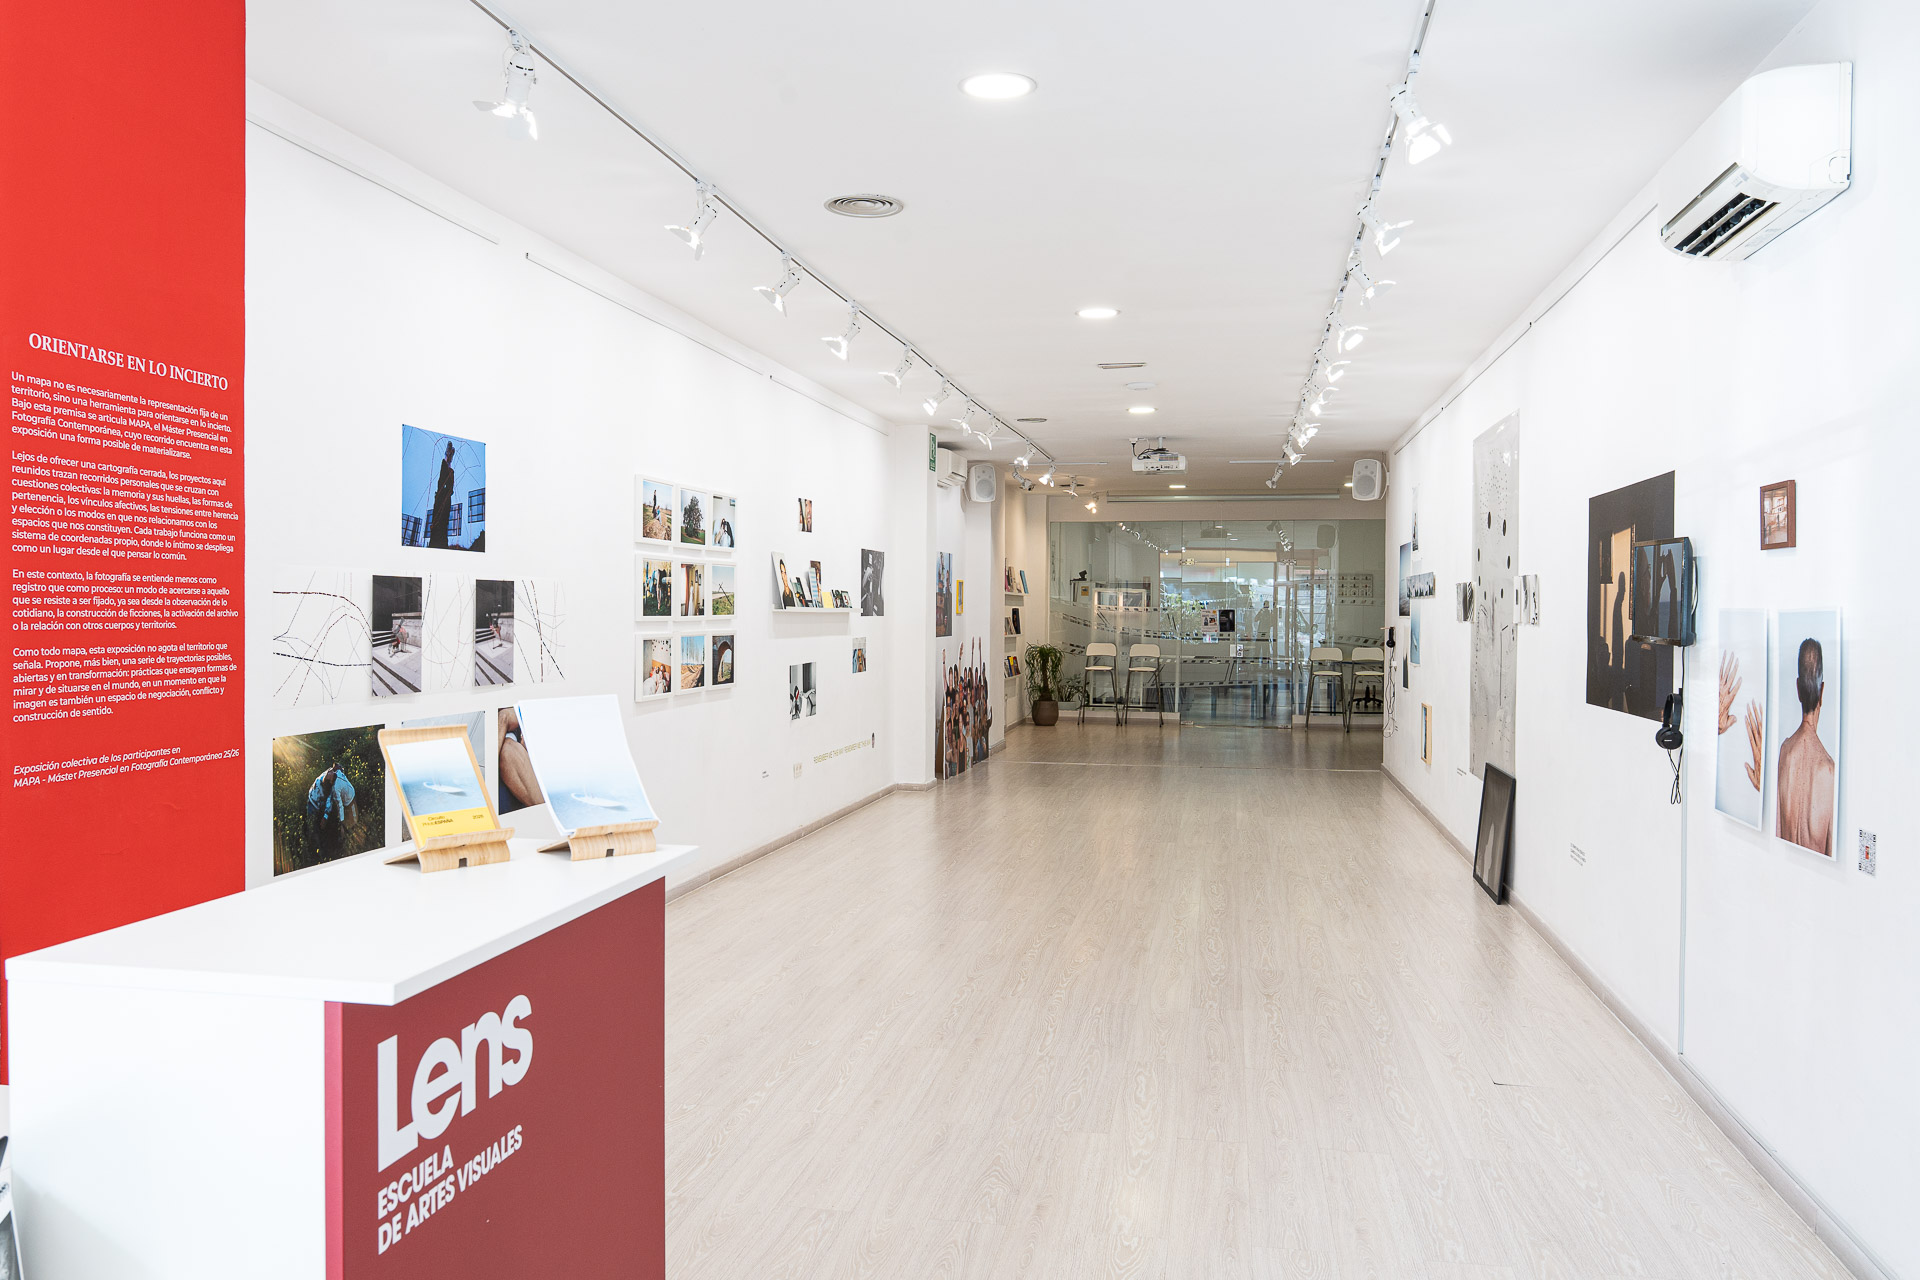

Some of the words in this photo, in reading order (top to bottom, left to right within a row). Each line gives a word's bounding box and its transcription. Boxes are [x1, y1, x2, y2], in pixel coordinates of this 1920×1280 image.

[28, 332, 124, 368] ORIENTARSE
[126, 354, 146, 373] EN
[148, 359, 167, 377] LO
[169, 364, 228, 391] INCIERTO
[11, 370, 25, 382] Un
[26, 375, 52, 388] mapa
[53, 380, 65, 390] no
[65, 383, 76, 392] es
[76, 385, 139, 404] necesariamente
[139, 395, 147, 405] la
[147, 399, 199, 415] representación
[199, 407, 210, 419] fija
[210, 410, 219, 420] de
[219, 413, 229, 421] un
[11, 397, 32, 411] Bajo
[33, 402, 52, 413] esta
[53, 406, 87, 419] premisa
[87, 412, 97, 421] se
[97, 413, 128, 426] articula
[128, 417, 153, 431] MAPA,
[153, 422, 161, 431] el
[161, 423, 185, 435] Máster
[186, 427, 219, 441] Presencial
[219, 435, 228, 443] en
[11, 410, 56, 426] Fotografía
[57, 418, 123, 438] Contemporánea,
[123, 430, 143, 441] cuyo
[143, 433, 175, 445] recorrido
[175, 439, 210, 451] encuentra
[210, 444, 219, 453] en
[219, 446, 233, 455] esta
[11, 425, 58, 439] exposición
[59, 432, 76, 442] una
[76, 433, 101, 446] forma
[102, 439, 131, 450] posible
[130, 442, 141, 452] de
[142, 445, 192, 459] materializarse.
[11, 450, 36, 463] Lejos
[36, 453, 49, 464] de
[49, 455, 79, 467] ofrecer
[80, 460, 96, 470] una
[97, 463, 139, 475] cartografía
[139, 468, 168, 480] cerrada,
[168, 470, 179, 480] los
[179, 474, 212, 485] proyectos
[211, 478, 227, 487] aquí
[11, 465, 51, 477] reunidos
[51, 468, 78, 480] trazan
[79, 473, 119, 485] recorridos
[120, 478, 160, 490] personales
[160, 483, 174, 492] que
[174, 484, 183, 492] se
[183, 485, 207, 495] cruzan
[206, 488, 219, 496] con
[11, 491, 66, 505] pertenencia,
[67, 494, 80, 505] los
[80, 496, 114, 508] vínculos
[114, 499, 149, 513] afectivos,
[149, 503, 160, 513] las
[160, 505, 194, 516] tensiones
[194, 509, 212, 518] entre
[212, 509, 239, 521] herencia
[11, 517, 50, 528] espacios
[51, 520, 68, 531] que
[69, 522, 85, 531] nos
[85, 523, 133, 535] constituyen.
[133, 525, 153, 536] Cada
[153, 527, 179, 539] trabajo
[178, 528, 208, 540] funciona
[208, 533, 227, 541] como
[11, 544, 38, 553] como
[39, 545, 51, 554] un
[52, 544, 75, 557] lugar
[75, 545, 101, 556] desde
[101, 547, 110, 557] el
[110, 549, 126, 559] que
[126, 550, 152, 560] pensar
[153, 550, 160, 559] lo
[160, 551, 187, 561] común.
[12, 568, 25, 579] En
[26, 570, 45, 579] este
[46, 571, 85, 582] contexto,
[85, 571, 94, 581] la
[94, 571, 132, 583] fotografía
[132, 574, 141, 582] se
[141, 573, 174, 583] entiende
[174, 576, 198, 584] menos
[12, 607, 56, 619] cotidiano,
[56, 608, 65, 618] la
[65, 608, 117, 618] construcción
[117, 608, 129, 618] de
[129, 608, 163, 619] ficciones,
[163, 608, 170, 618] la
[171, 608, 205, 618] activación
[205, 608, 216, 617] del
[216, 608, 239, 617] archivo
[12, 623, 19, 631] o
[20, 621, 29, 631] la
[30, 620, 64, 631] relación
[65, 622, 81, 630] con
[82, 621, 104, 630] otros
[103, 622, 135, 631] cuerpos
[135, 622, 141, 631] y
[141, 620, 177, 629] territorios.
[12, 647, 40, 657] Como
[40, 646, 61, 656] todo
[62, 647, 88, 657] mapa,
[88, 646, 106, 655] esta
[106, 643, 146, 656] exposición
[147, 645, 157, 653] no
[157, 644, 178, 654] agota
[178, 642, 186, 652] el
[186, 641, 215, 651] territorio
[215, 643, 228, 652] que
[12, 659, 44, 670] señala.
[45, 659, 82, 670] Propone,
[83, 657, 101, 667] más
[101, 656, 121, 667] bien,
[121, 657, 137, 665] una
[137, 655, 155, 665] serie
[155, 655, 166, 664] de
[166, 653, 206, 665] trayectorias
[206, 652, 233, 663] posibles,
[12, 709, 69, 723] construcción
[69, 708, 81, 718] de
[81, 705, 114, 717] sentido.
[13, 760, 60, 776] Exposición
[60, 756, 98, 769] colectiva
[98, 754, 110, 764] de
[110, 753, 122, 762] los
[122, 748, 171, 763] participantes
[171, 746, 181, 754] en
[13, 775, 41, 788] MAPA
[47, 772, 78, 784] Máster
[77, 764, 119, 779] Presencial
[119, 765, 130, 773] en
[130, 758, 169, 772] Fotografía
[169, 752, 223, 766] Contemporánea
[222, 748, 240, 759] 25/26
[377, 994, 534, 1173] Lens
[377, 1144, 454, 1221] ESCUELA
[377, 1211, 402, 1256] DE
[404, 1174, 455, 1235] ARTES
[456, 1124, 523, 1193] VISUALES
